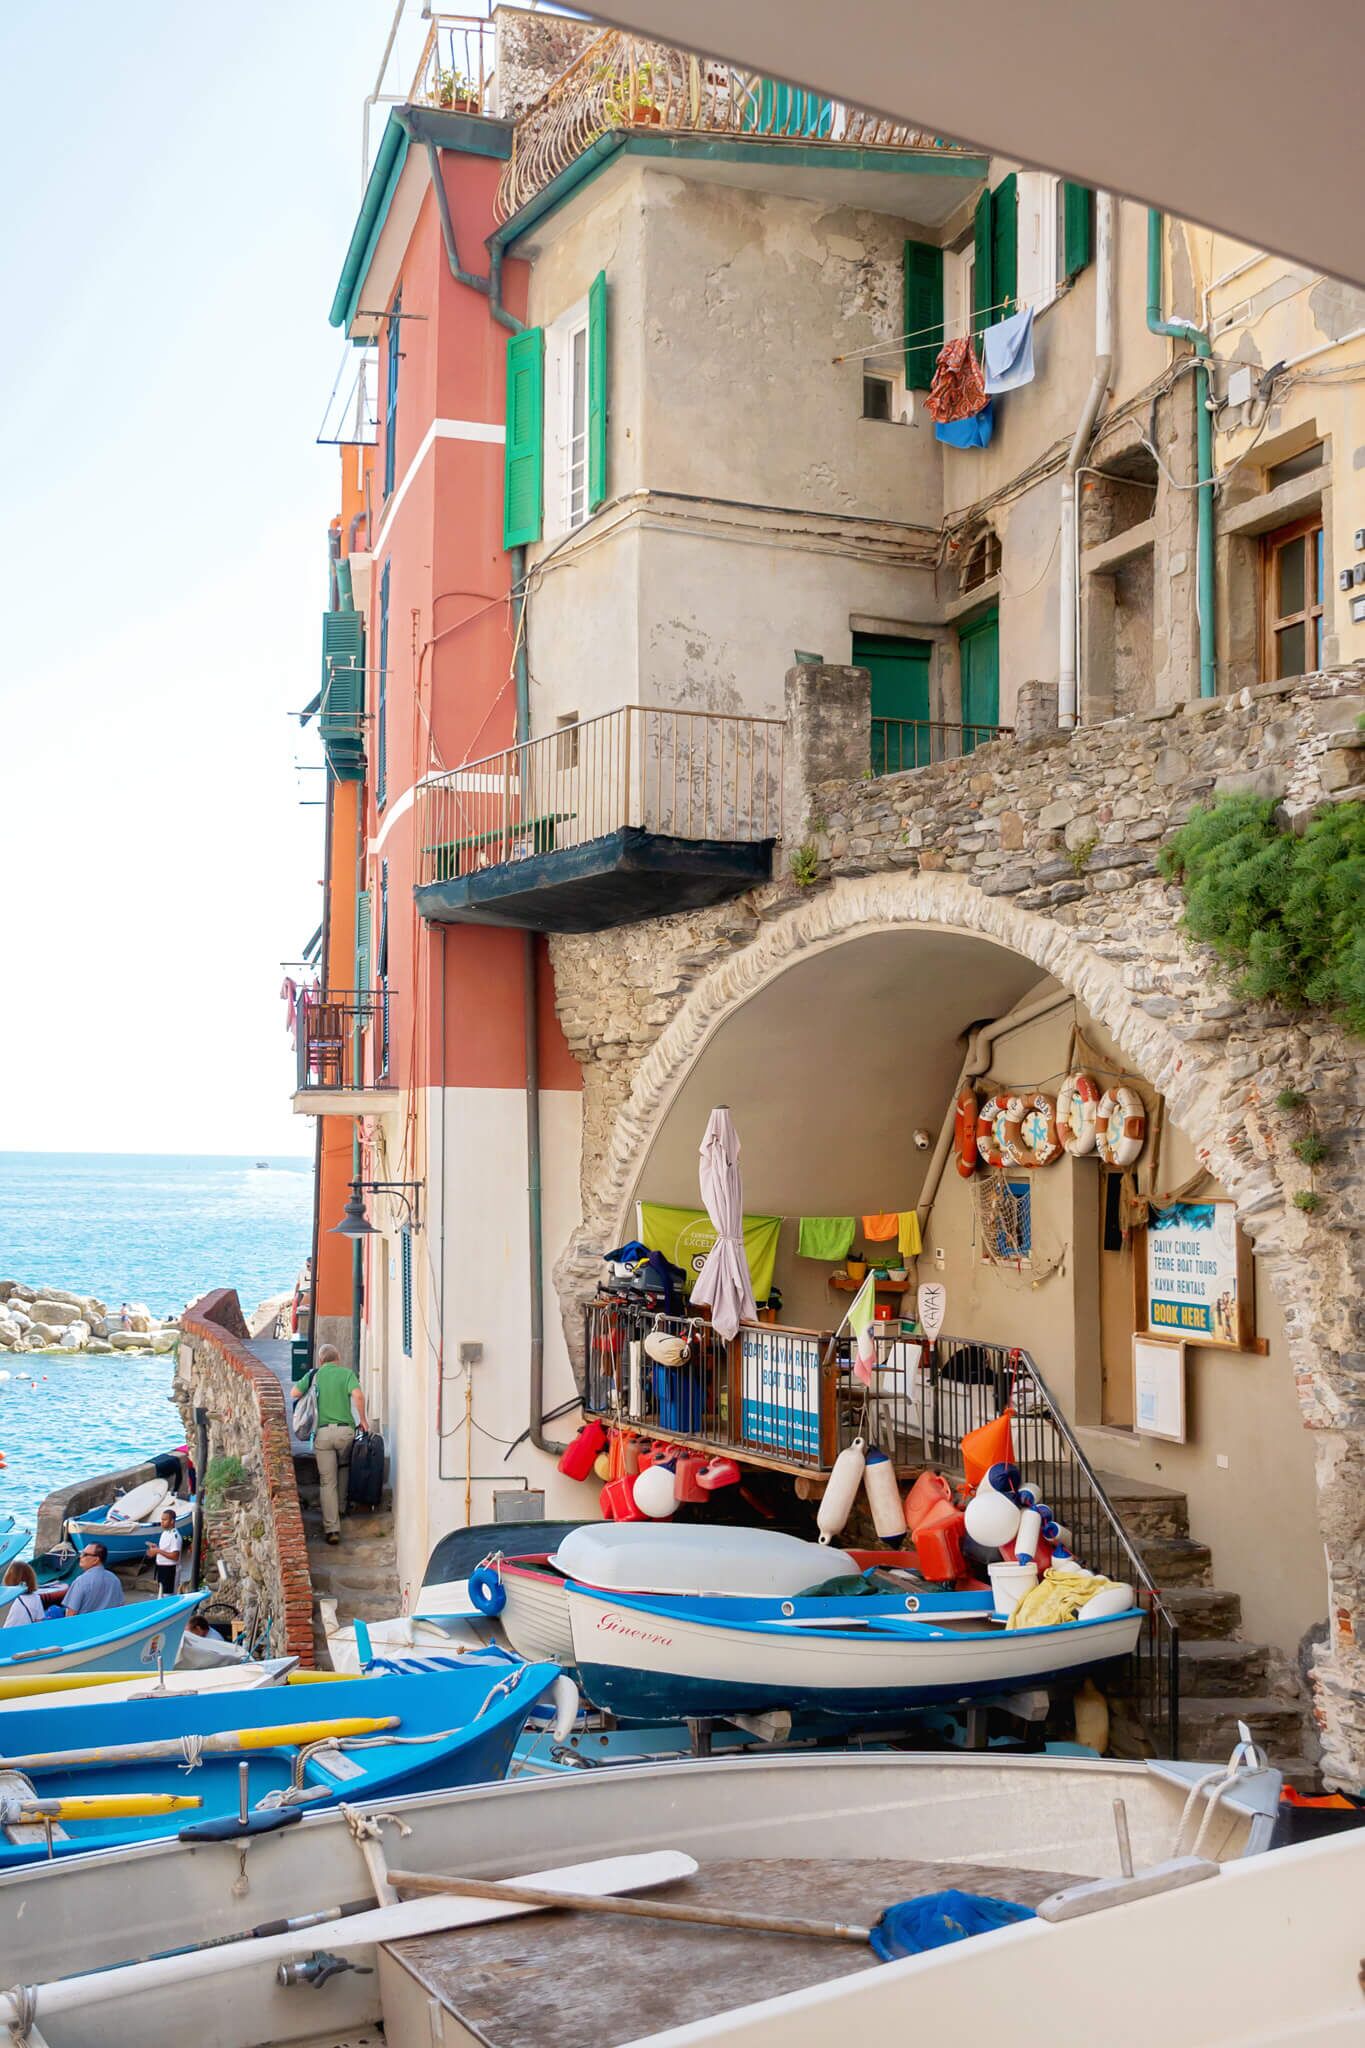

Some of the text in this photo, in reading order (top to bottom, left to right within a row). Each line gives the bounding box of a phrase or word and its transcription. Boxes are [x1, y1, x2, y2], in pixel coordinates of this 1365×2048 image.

[1154, 1239, 1200, 1256] DAILY CINQUE
[1154, 1256, 1217, 1275] TERRE BOAT TOURS
[1155, 1278, 1205, 1296] KAYAK RENTALS
[925, 1286, 941, 1329] KAYAK
[1154, 1303, 1206, 1328] BOOK HERE
[596, 1613, 673, 1646] Ginevra
